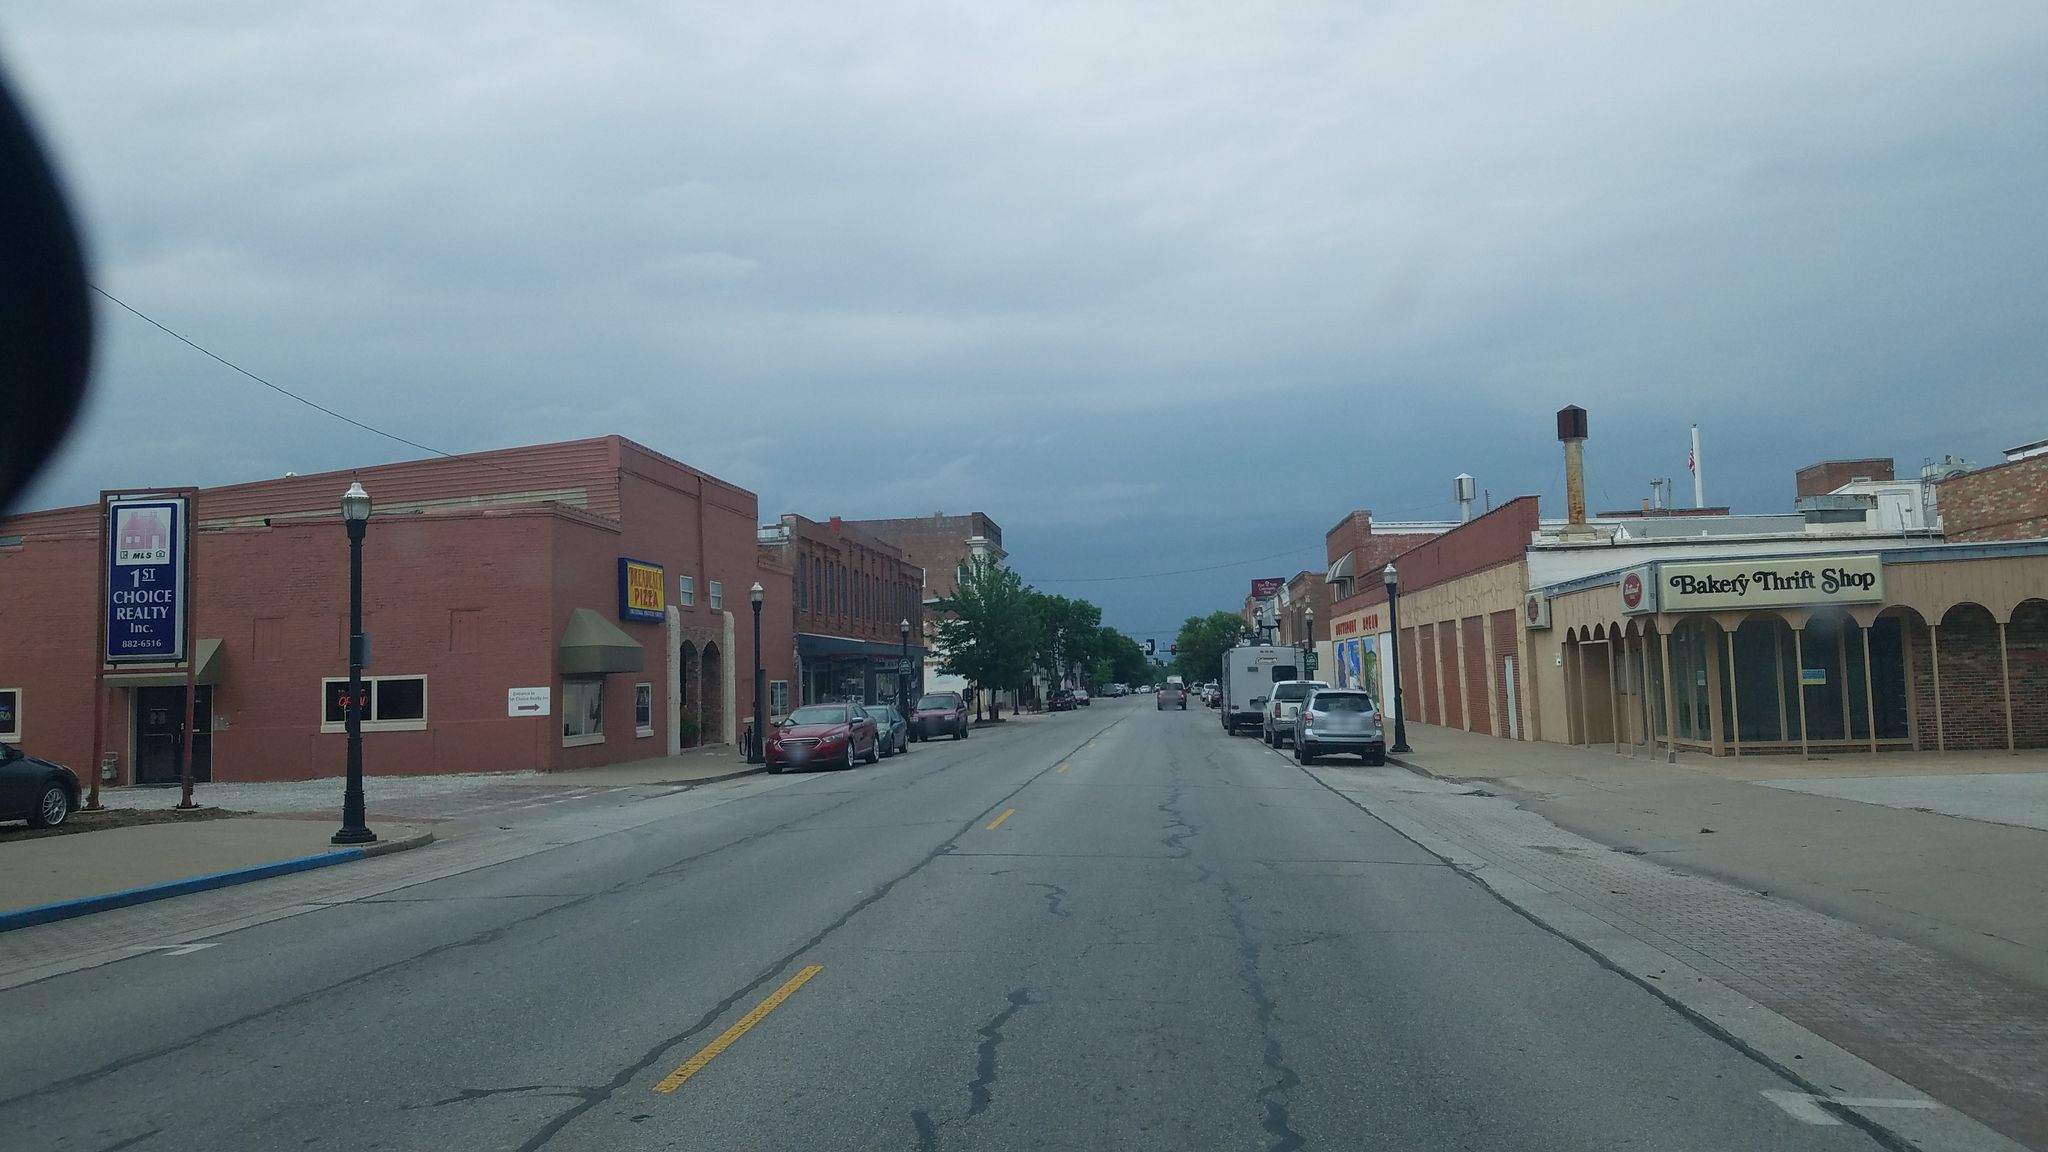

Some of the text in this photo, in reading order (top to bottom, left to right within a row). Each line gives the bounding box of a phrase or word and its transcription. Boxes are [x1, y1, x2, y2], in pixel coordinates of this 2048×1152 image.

[132, 552, 152, 560] MLS
[130, 568, 156, 588] 1ST
[1669, 568, 1875, 596] Bakery Thrift Shop
[113, 589, 172, 604] CHOICE
[633, 587, 659, 609] PIZZA
[116, 606, 169, 620] REALTY
[130, 622, 154, 633] Inc.
[122, 639, 162, 649] 882-6516
[338, 696, 366, 708] OPN
